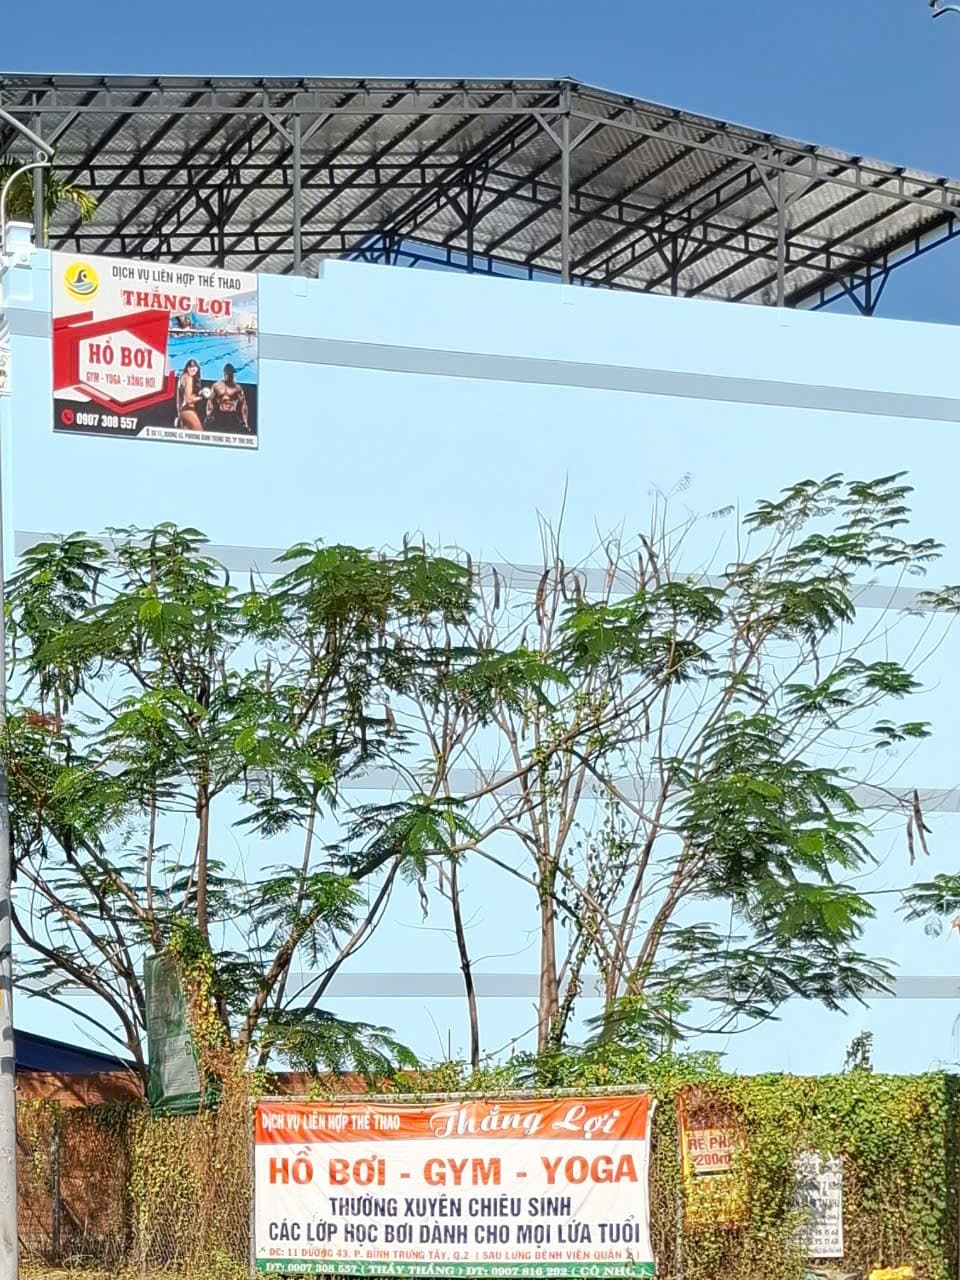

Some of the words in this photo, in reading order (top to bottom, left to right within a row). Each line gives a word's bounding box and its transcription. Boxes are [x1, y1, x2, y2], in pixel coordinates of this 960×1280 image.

[112, 265, 135, 280] DỊCH
[138, 268, 150, 284] VỤ
[152, 269, 174, 284] LIÊN
[218, 276, 241, 290] THAO
[88, 336, 114, 366] HỒ
[120, 345, 153, 369] BƠI
[76, 412, 99, 426] 0907
[120, 416, 138, 430] 557
[261, 1113, 284, 1131] DỊCH
[303, 1110, 325, 1130] LIÊN
[373, 1113, 401, 1130] THAO
[551, 1104, 621, 1139] Lợi
[269, 1146, 314, 1185] HỒ
[328, 1153, 386, 1186] BƠI
[423, 1156, 501, 1186] GYM
[540, 1153, 639, 1185] YOGA
[329, 1193, 397, 1217] THƯỜNG
[404, 1193, 462, 1217] XUYÊN
[468, 1193, 521, 1217] CHIÊU
[528, 1196, 572, 1217] SINH
[269, 1218, 301, 1241] CÁC
[306, 1218, 338, 1242] LỚP
[344, 1223, 378, 1247] HỌC
[384, 1223, 413, 1244] BƠI
[419, 1220, 468, 1244] DÀNH
[474, 1224, 510, 1244] CHO
[516, 1224, 551, 1248] MỌI
[557, 1219, 592, 1244] LỨA
[597, 1214, 640, 1243] TUỔI
[287, 1248, 298, 1257] 11
[482, 1250, 502, 1260] SAU
